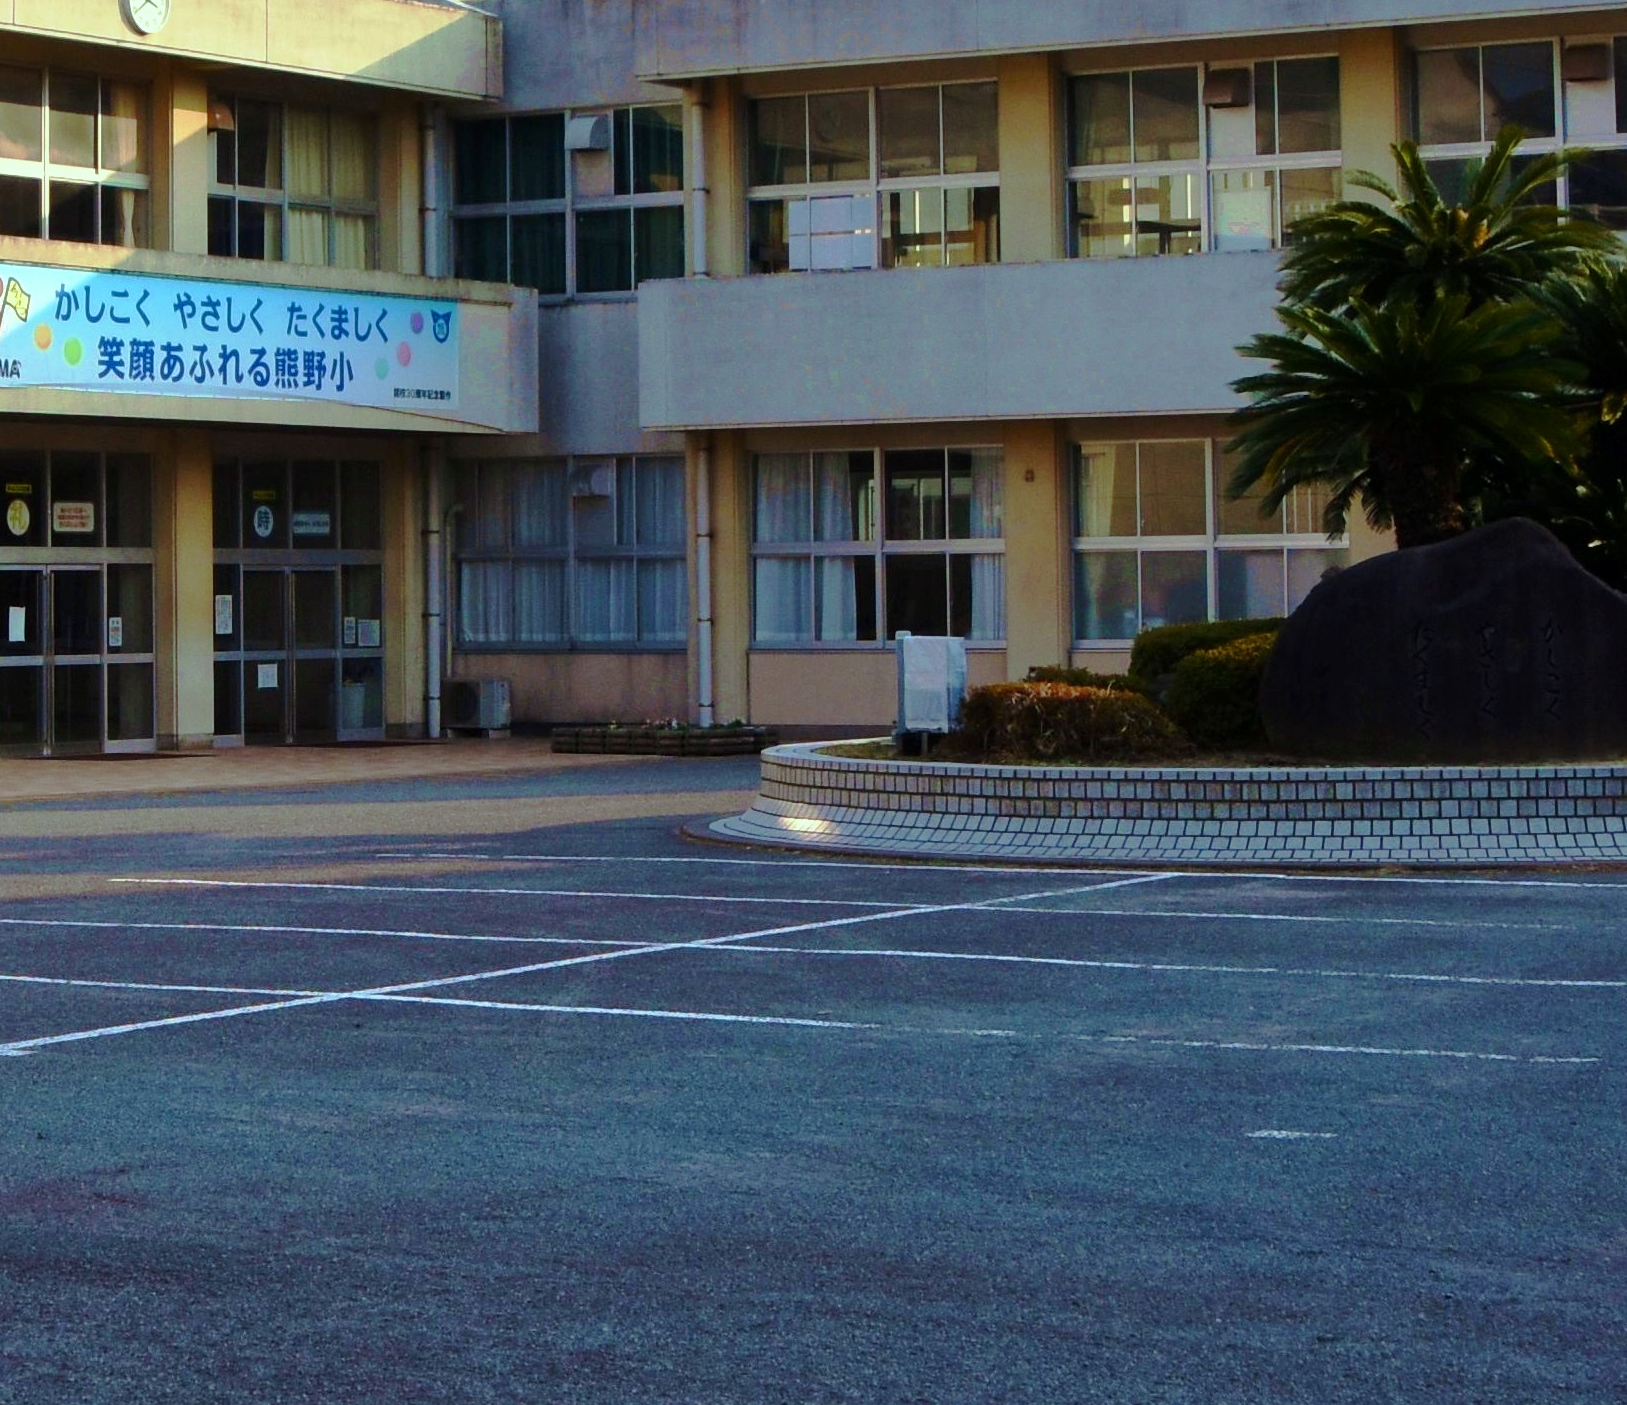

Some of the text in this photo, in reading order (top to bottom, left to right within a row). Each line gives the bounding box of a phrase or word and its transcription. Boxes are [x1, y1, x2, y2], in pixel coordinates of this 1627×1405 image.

[54, 283, 151, 327] かしこく
[173, 292, 264, 335] やさしく
[286, 301, 389, 344] たくましく
[96, 335, 354, 392] 笑顔あふれる熊野小
